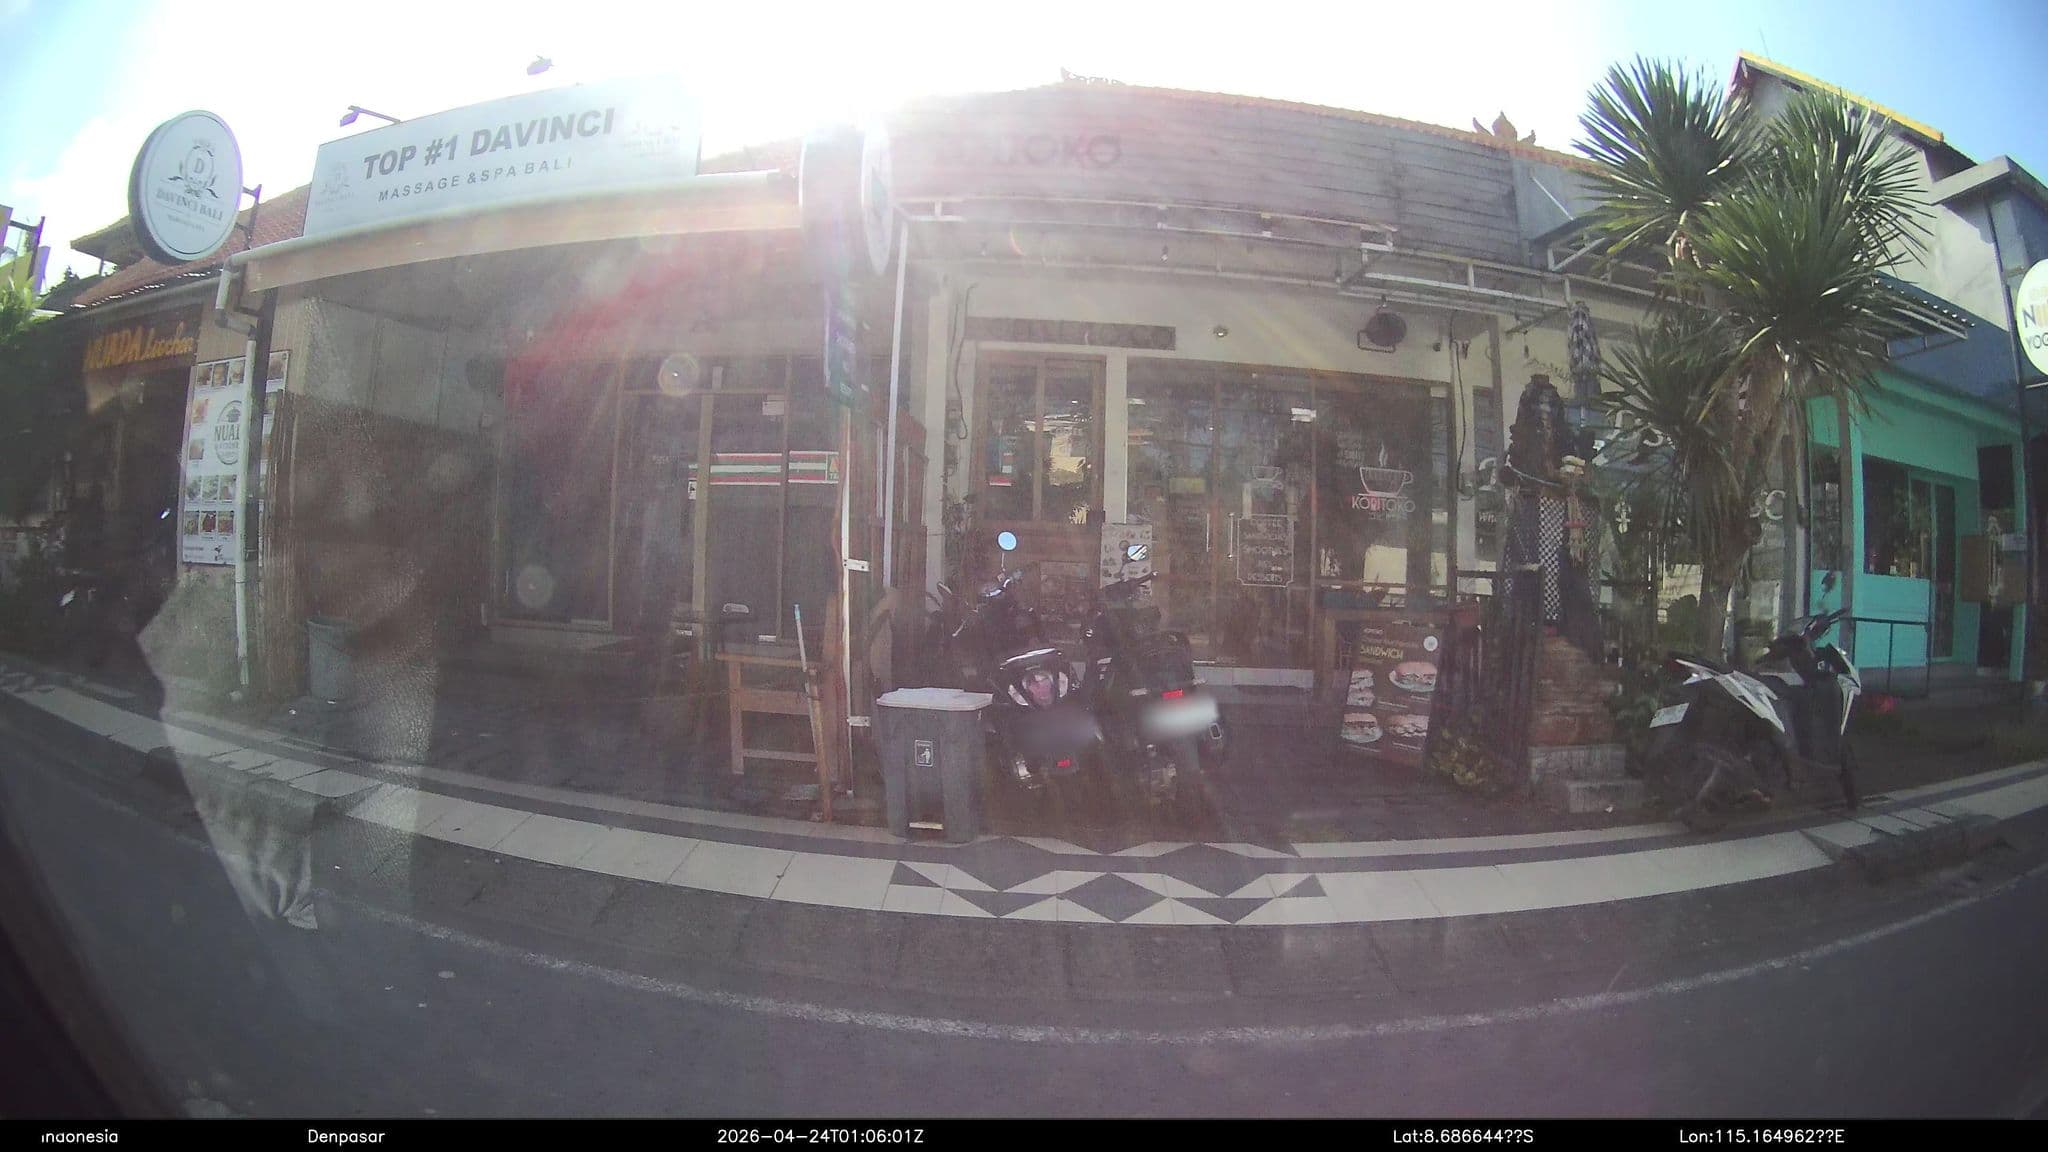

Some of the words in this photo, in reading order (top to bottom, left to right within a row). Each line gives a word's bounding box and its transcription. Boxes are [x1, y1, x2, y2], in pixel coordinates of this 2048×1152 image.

[364, 145, 417, 179] TOP
[424, 134, 458, 166] #1
[470, 107, 615, 156] DAVINCI
[378, 175, 460, 202] MASSAGE
[524, 157, 572, 175] BALI
[156, 187, 199, 213] DAVINCI
[199, 204, 224, 221] BALI
[1360, 645, 1404, 660] SANDWICH
